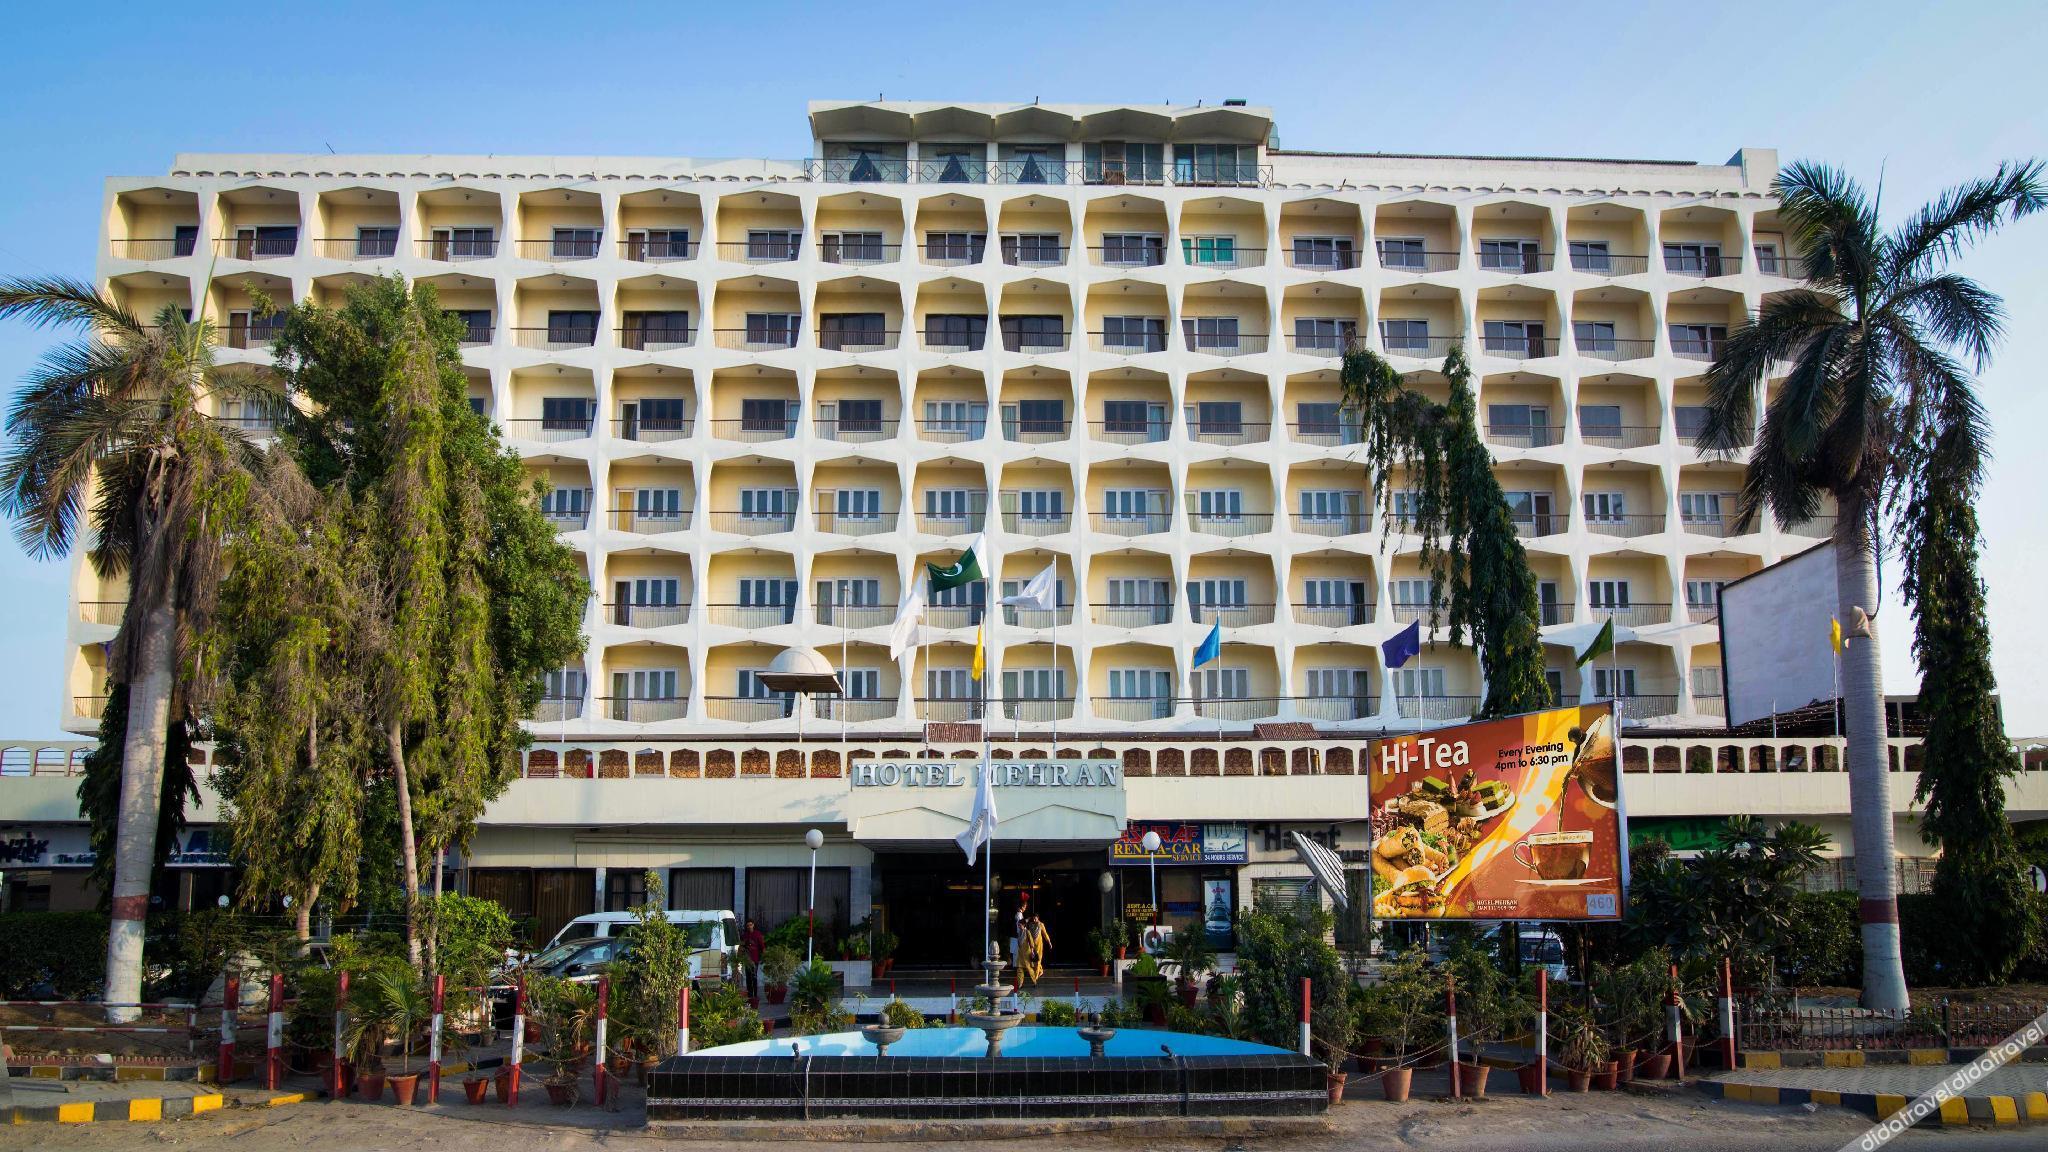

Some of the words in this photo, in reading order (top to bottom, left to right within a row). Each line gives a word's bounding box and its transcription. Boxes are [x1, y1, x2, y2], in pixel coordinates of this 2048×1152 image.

[1382, 737, 1470, 775] Hi-Tea
[1498, 747, 1523, 758] Every
[1525, 742, 1564, 755] Evening
[1495, 760, 1516, 772] 4pm
[1518, 758, 1528, 767] to
[1530, 755, 1549, 766] 6:30
[1551, 754, 1569, 766] pm
[855, 763, 965, 787] HOTEL
[976, 763, 1119, 787] MEHRAN
